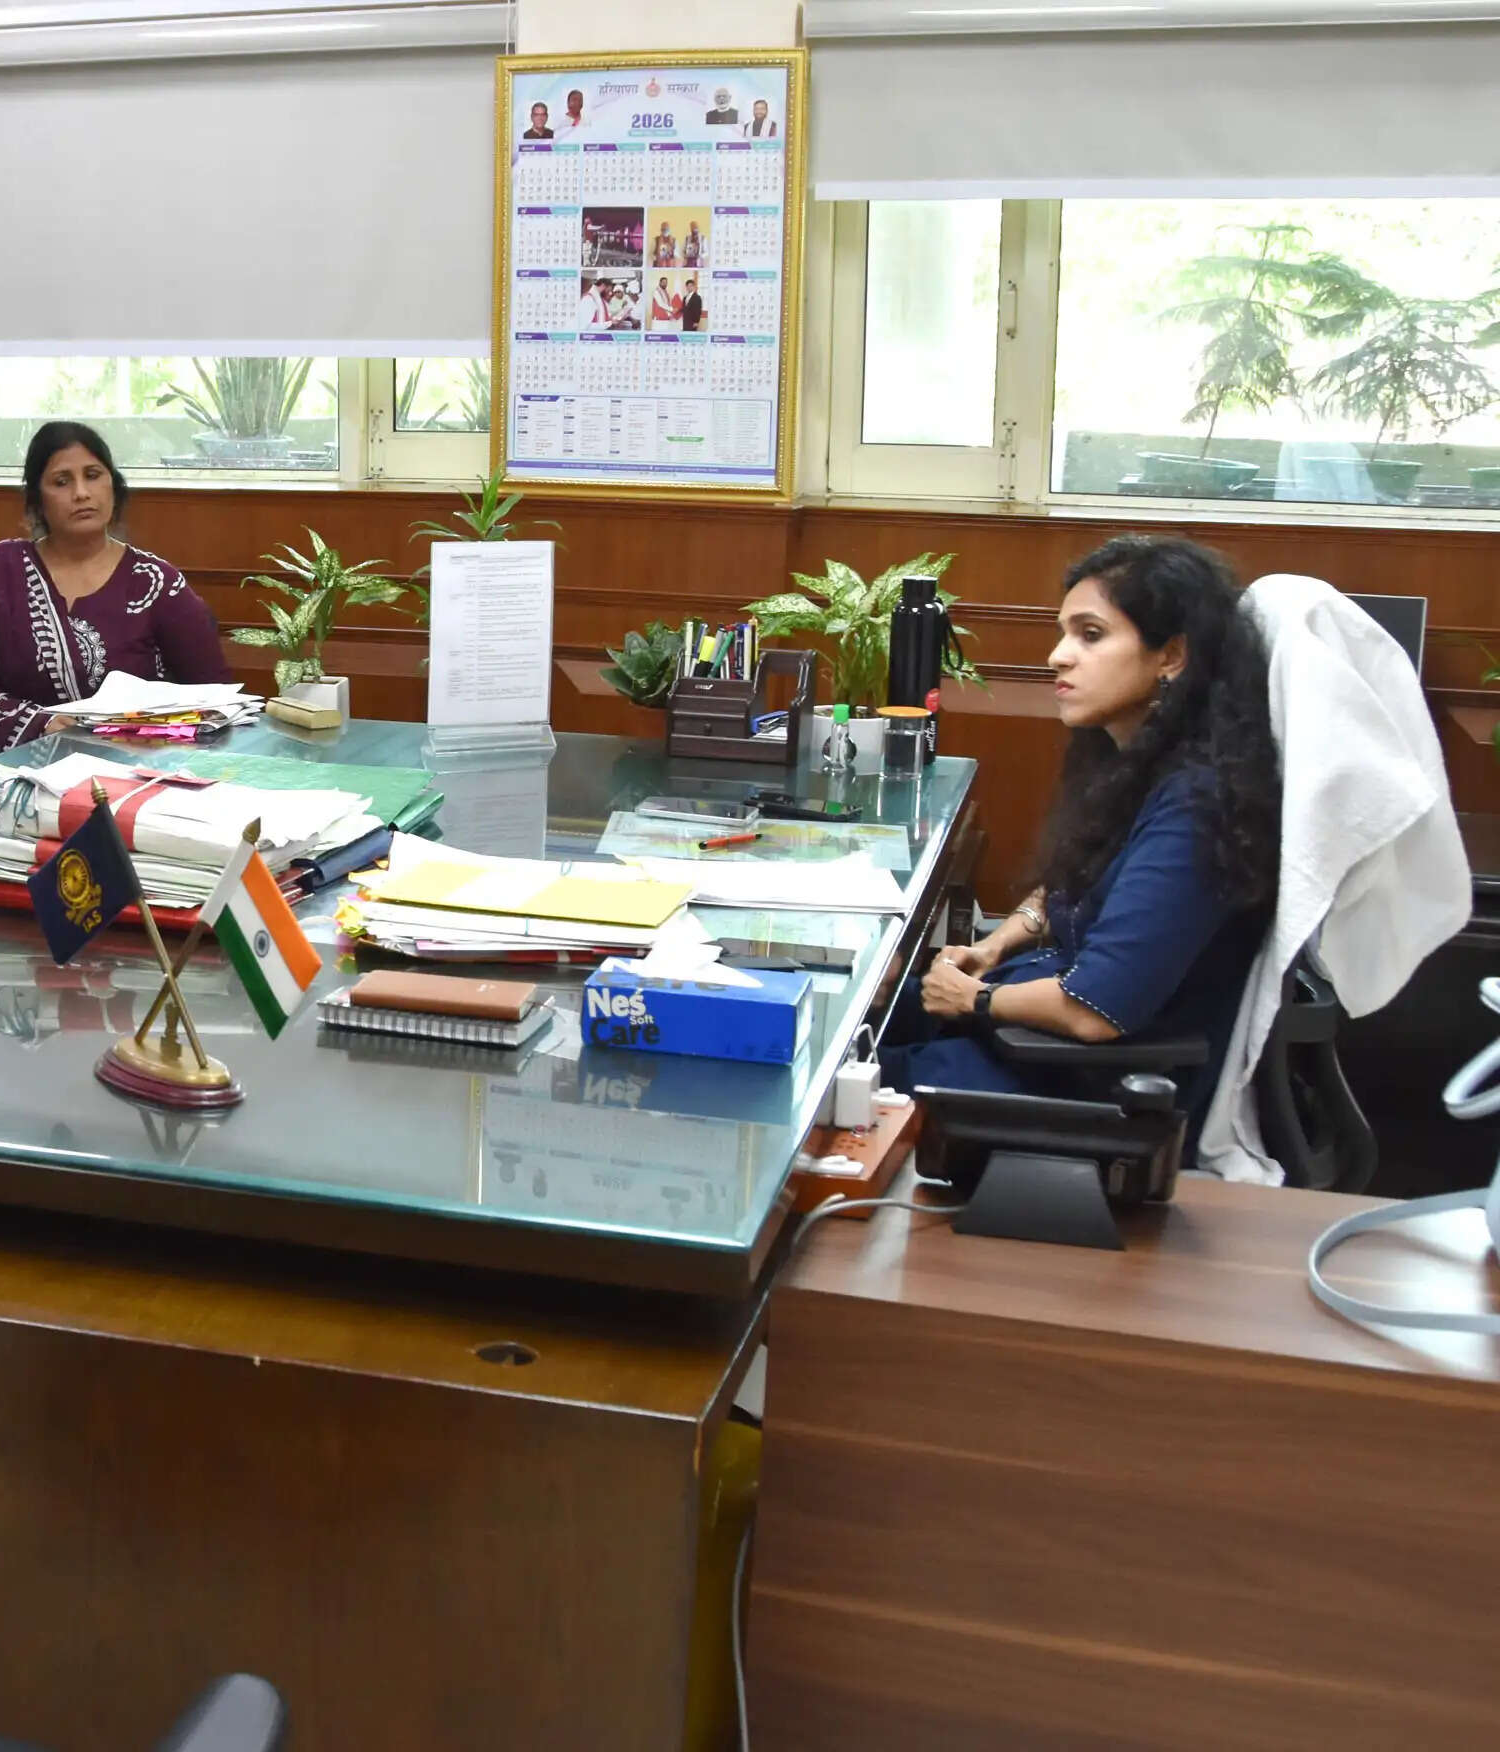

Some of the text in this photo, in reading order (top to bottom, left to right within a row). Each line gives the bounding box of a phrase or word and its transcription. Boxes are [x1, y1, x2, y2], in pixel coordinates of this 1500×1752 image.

[631, 113, 674, 128] 2026
[629, 1014, 655, 1026] Soft
[590, 1018, 661, 1047] Care
